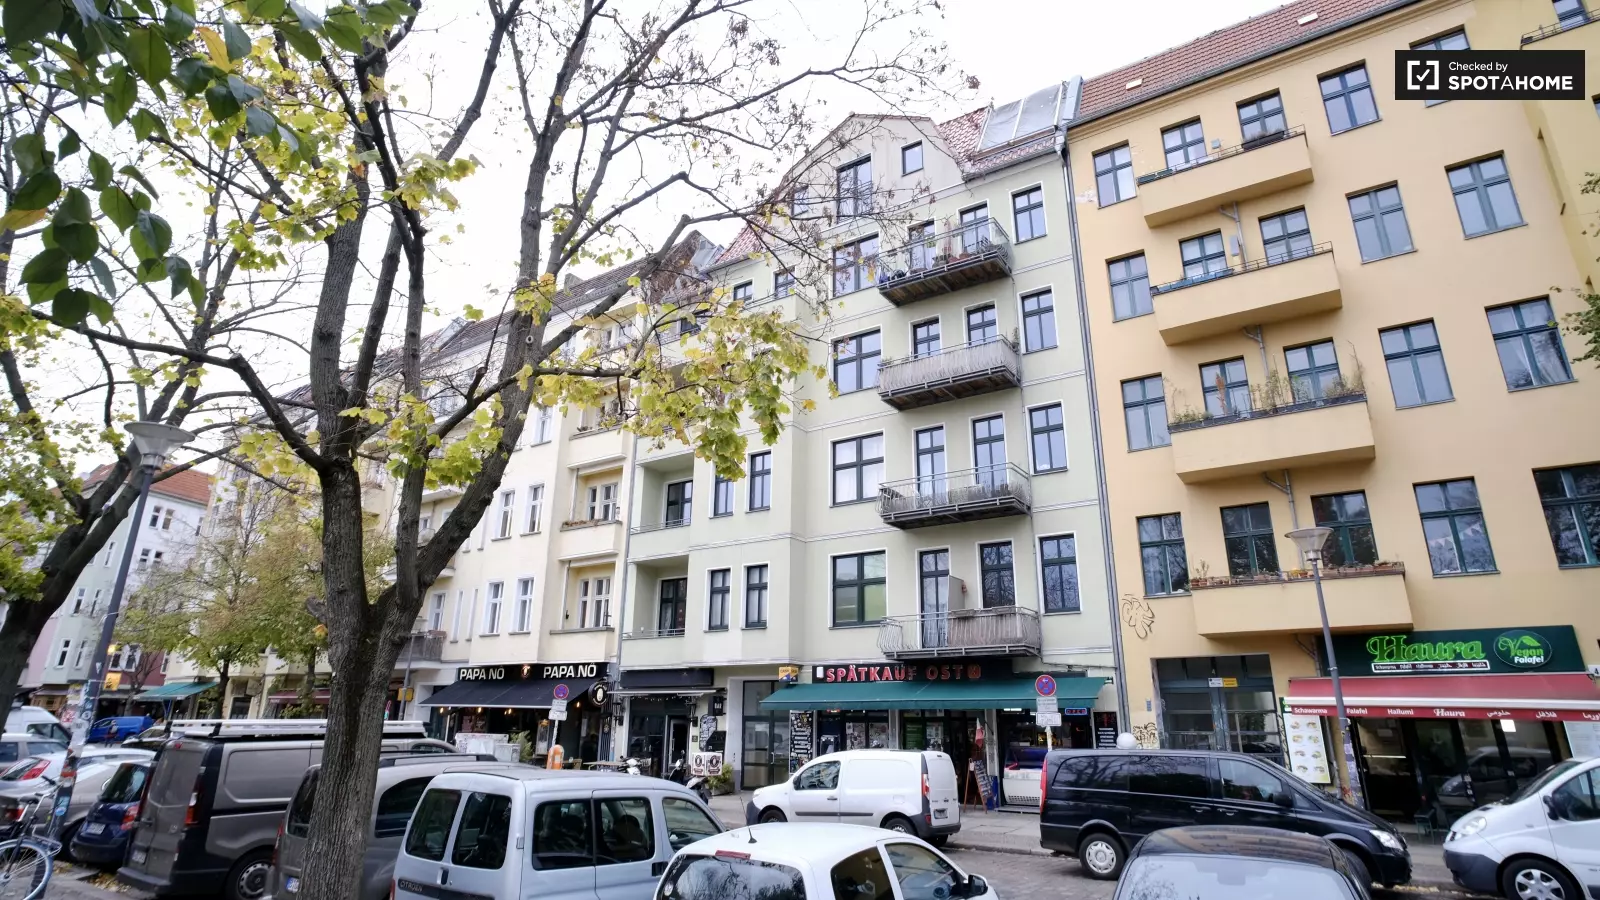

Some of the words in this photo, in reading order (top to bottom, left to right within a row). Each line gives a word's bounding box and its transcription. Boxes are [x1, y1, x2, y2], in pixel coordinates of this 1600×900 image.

[1366, 635, 1486, 662] Haura
[1498, 636, 1544, 657] Vegan
[1514, 656, 1544, 665] Falafel
[459, 669, 487, 681] PAPA
[543, 666, 575, 678] PAPA
[826, 665, 917, 683] SPÄTKAUF
[925, 665, 962, 680] OST
[1433, 708, 1465, 717] Haura
